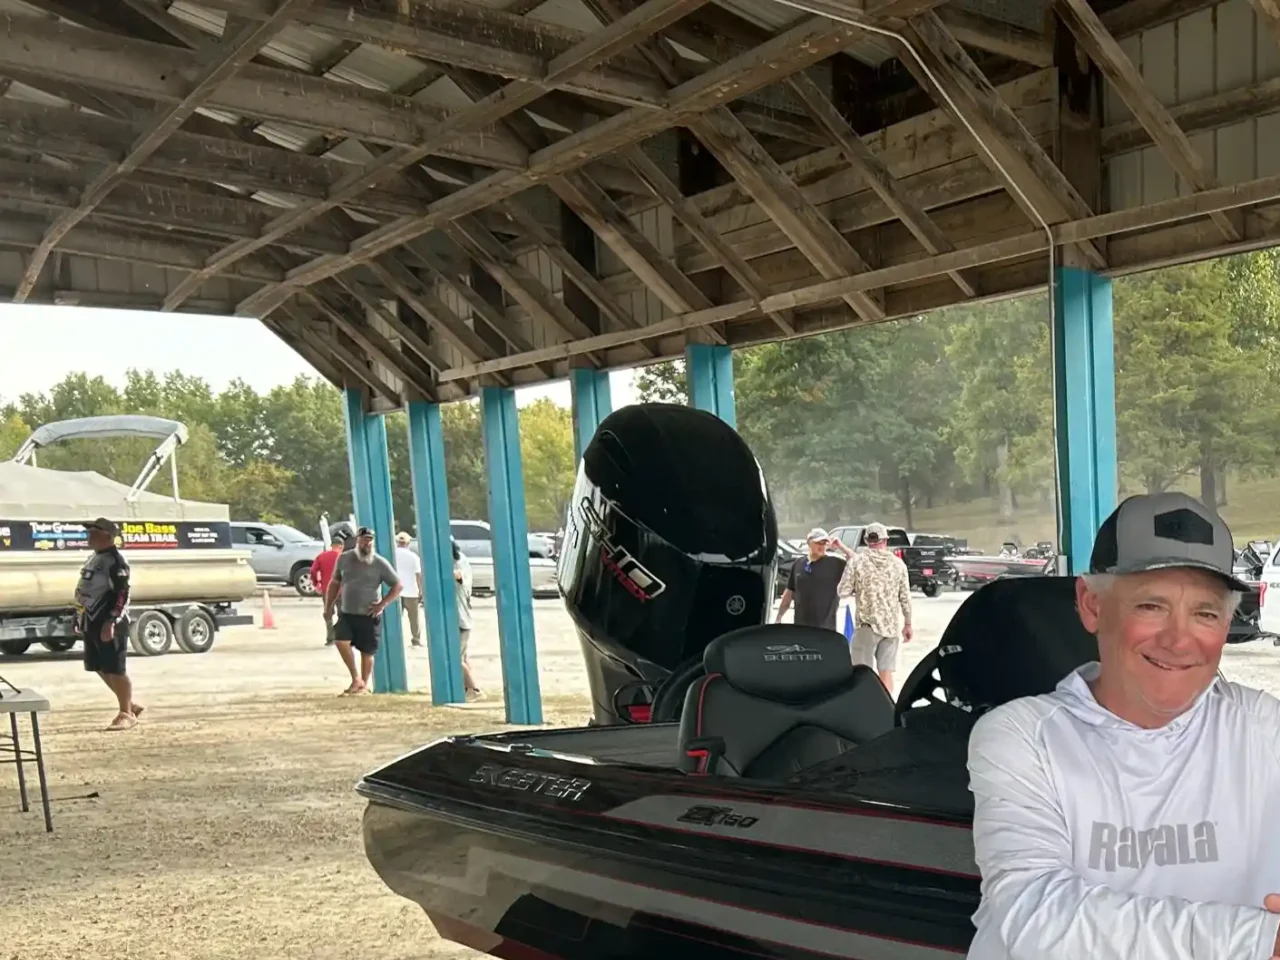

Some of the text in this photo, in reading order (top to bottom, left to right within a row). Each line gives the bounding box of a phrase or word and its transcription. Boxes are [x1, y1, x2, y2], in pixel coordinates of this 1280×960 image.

[122, 522, 177, 533] Joe Bass
[121, 533, 150, 542] TEAM
[150, 533, 178, 542] TRAIL
[763, 653, 823, 662] SKEETER
[468, 762, 592, 801] SKEETER
